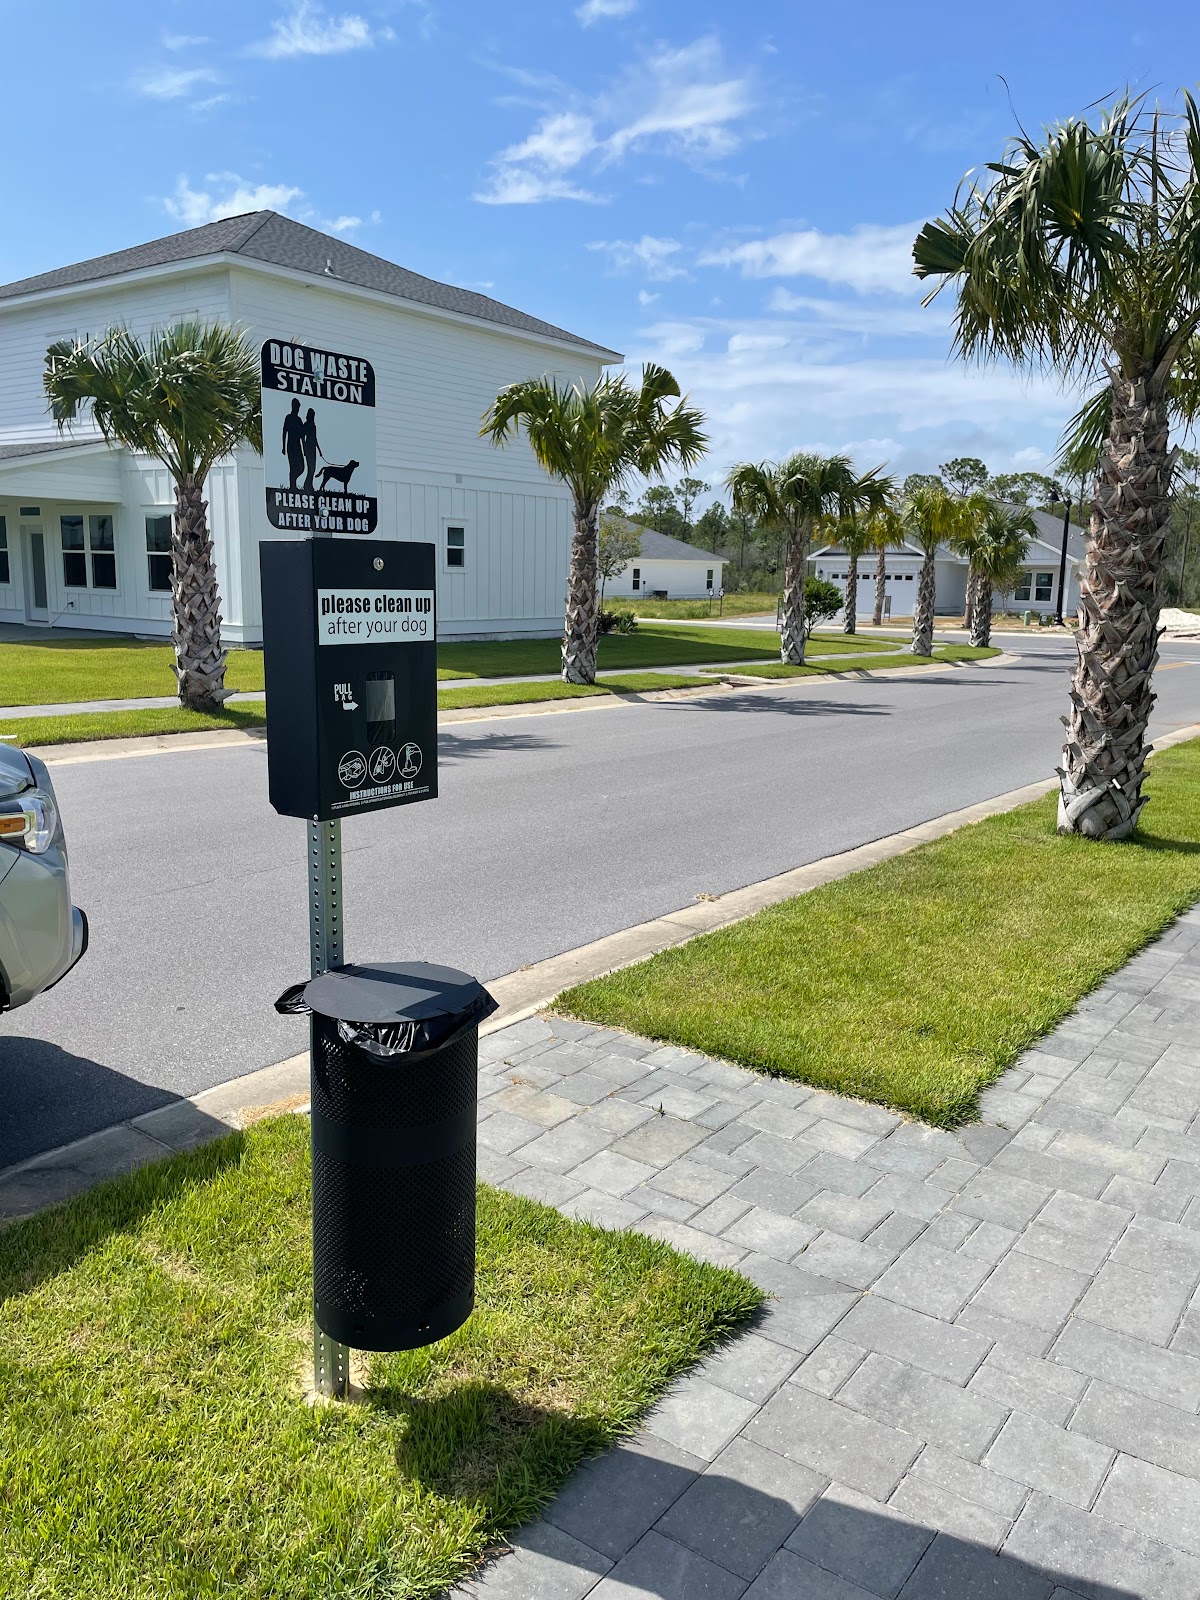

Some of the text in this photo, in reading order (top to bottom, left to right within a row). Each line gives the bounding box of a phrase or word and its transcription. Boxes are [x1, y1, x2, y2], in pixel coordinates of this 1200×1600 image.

[270, 342, 368, 383] DOG WASTE
[277, 371, 363, 404] STATION
[275, 492, 370, 514] PLEASE CLEAN UP
[278, 512, 369, 532] AFTER YOUR DOG
[321, 594, 431, 615] please clean up
[328, 615, 427, 638] after your dog
[334, 683, 352, 695] PULL
[349, 784, 392, 801] INSTRUCTIONS
[392, 782, 403, 793] FOR
[403, 780, 414, 790] USE
